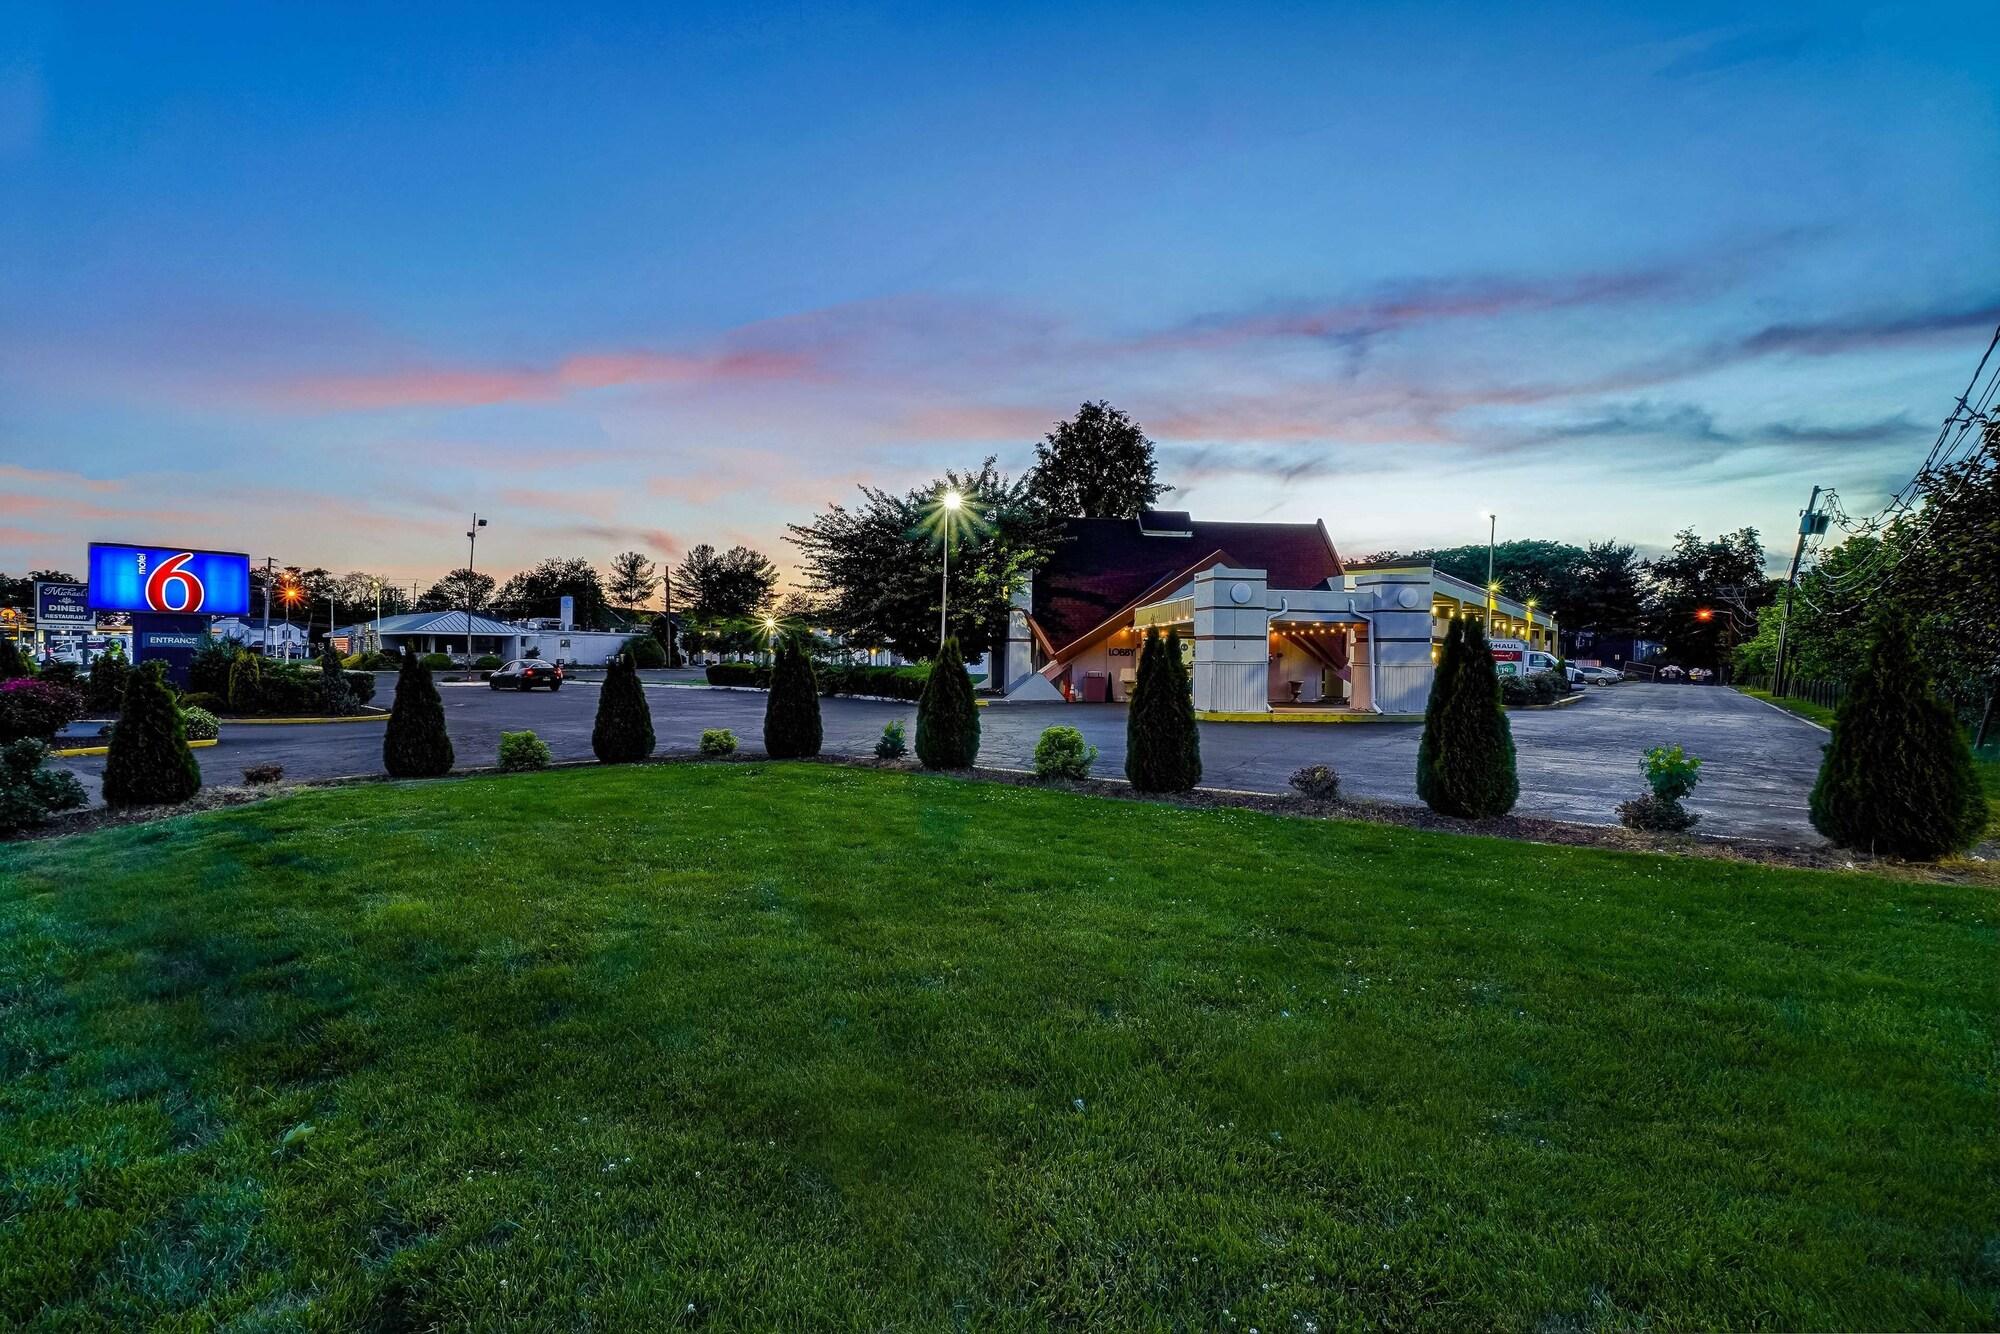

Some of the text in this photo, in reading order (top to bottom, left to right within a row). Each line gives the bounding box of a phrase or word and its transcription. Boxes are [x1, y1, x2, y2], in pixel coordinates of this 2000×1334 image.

[137, 553, 146, 575] motel
[145, 552, 205, 612] 6
[48, 604, 84, 612] DINER
[1108, 648, 1136, 656] LOBBY
